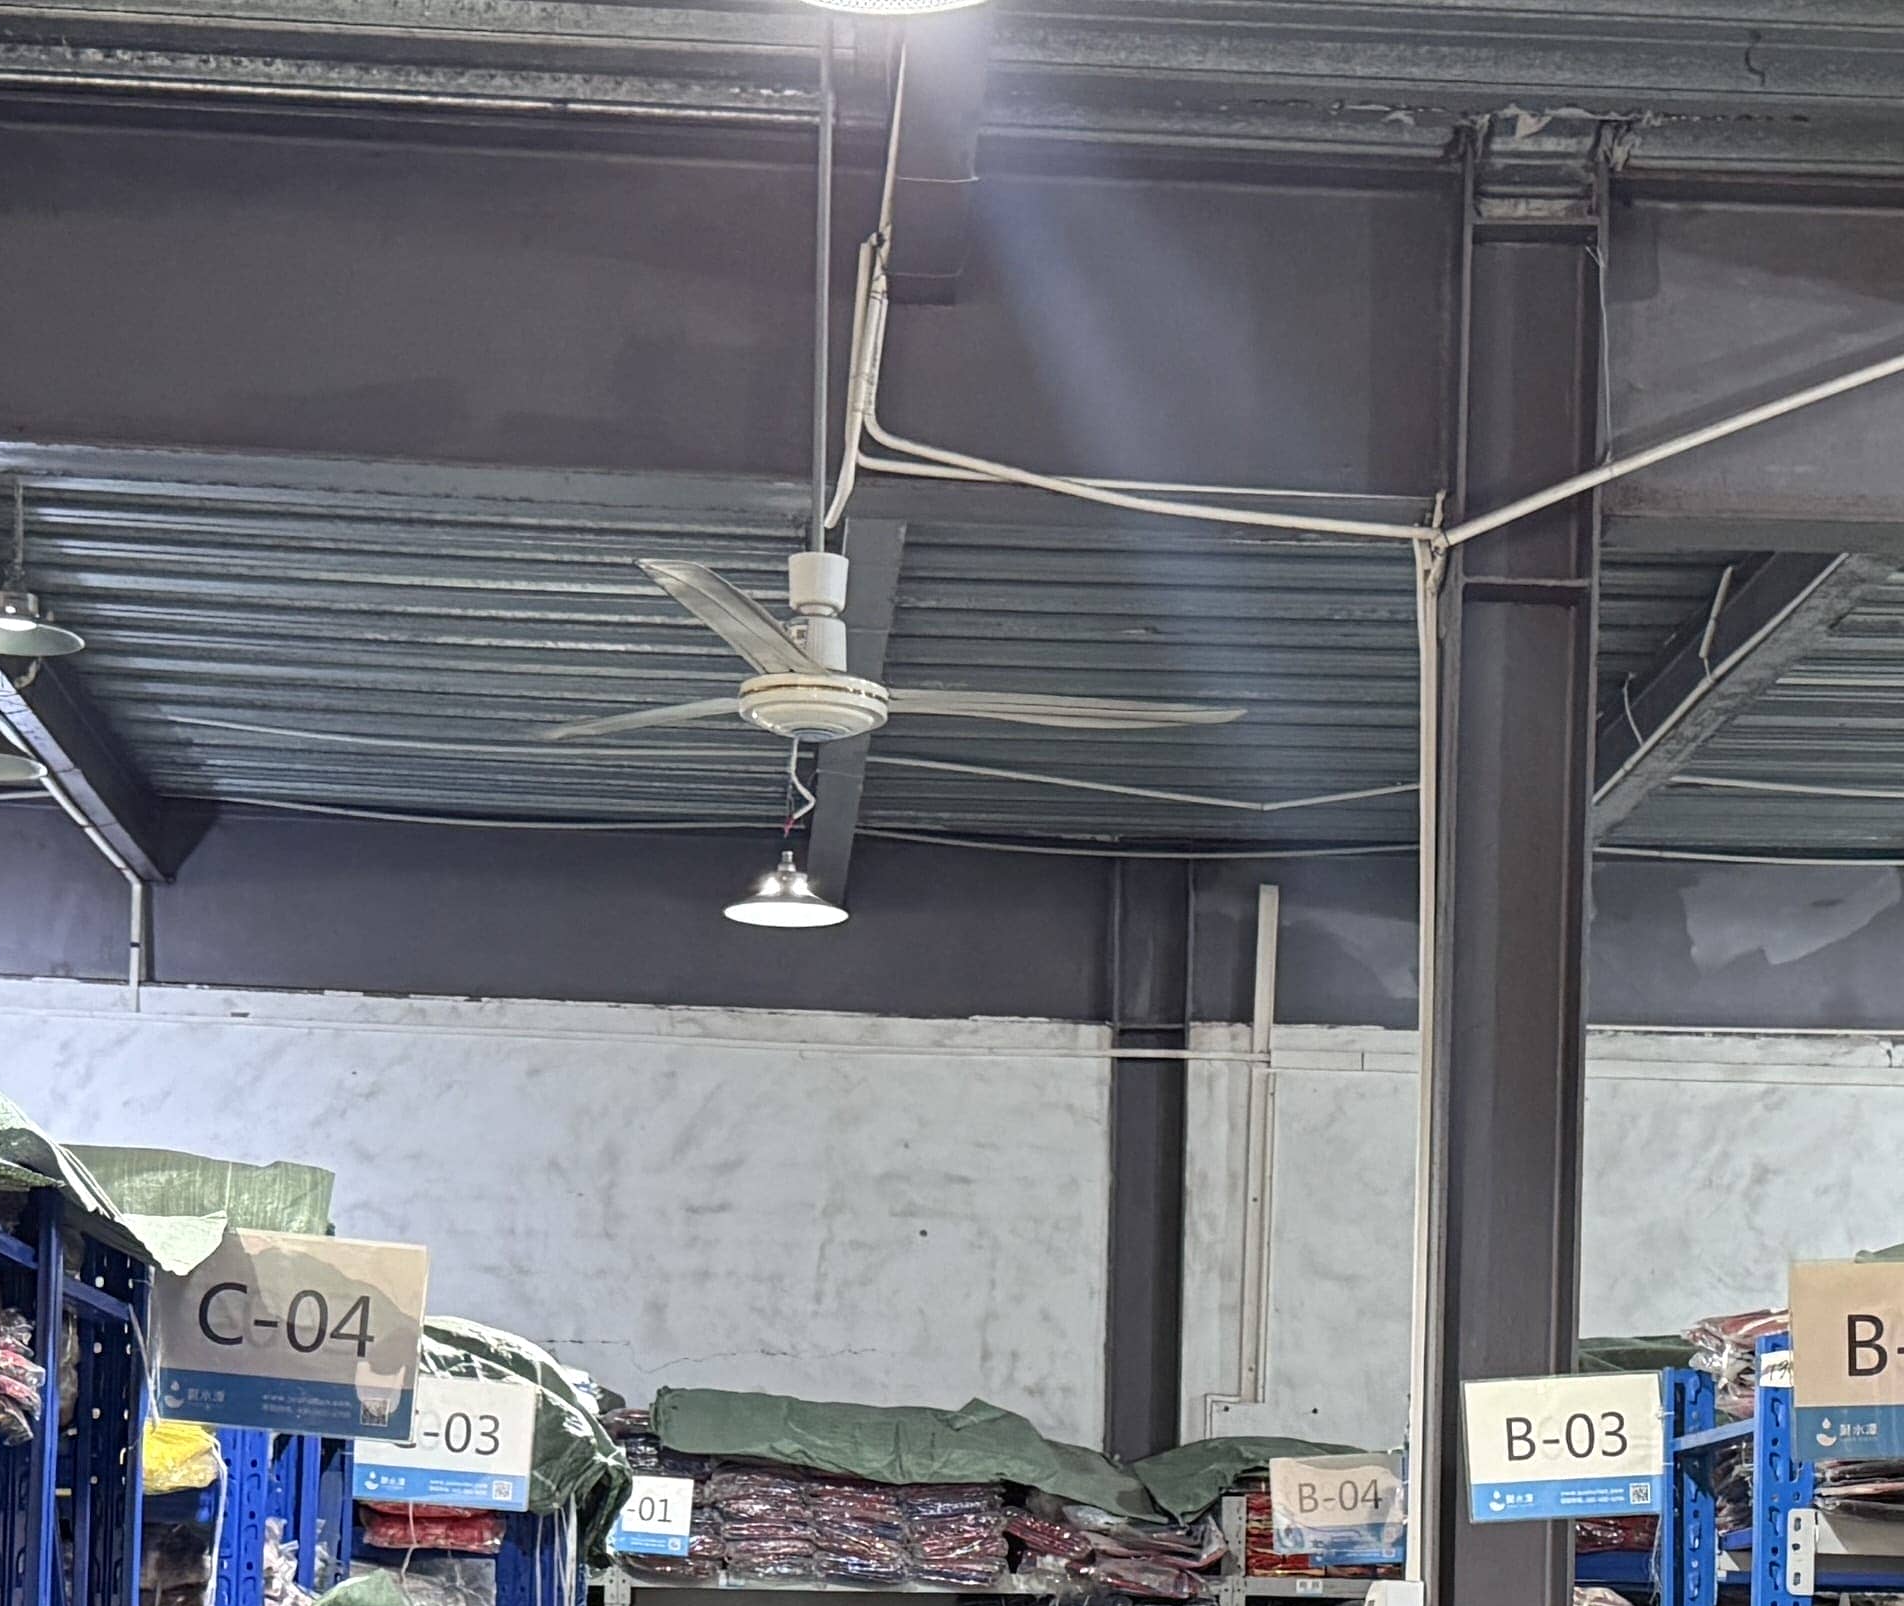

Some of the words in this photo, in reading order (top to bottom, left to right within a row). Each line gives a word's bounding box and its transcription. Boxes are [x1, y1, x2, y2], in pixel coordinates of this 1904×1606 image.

[197, 1281, 376, 1358] C-04
[393, 1411, 501, 1456] -03
[1505, 1411, 1628, 1462] B-03
[626, 1496, 673, 1523] -01
[1297, 1478, 1384, 1514] B-04
